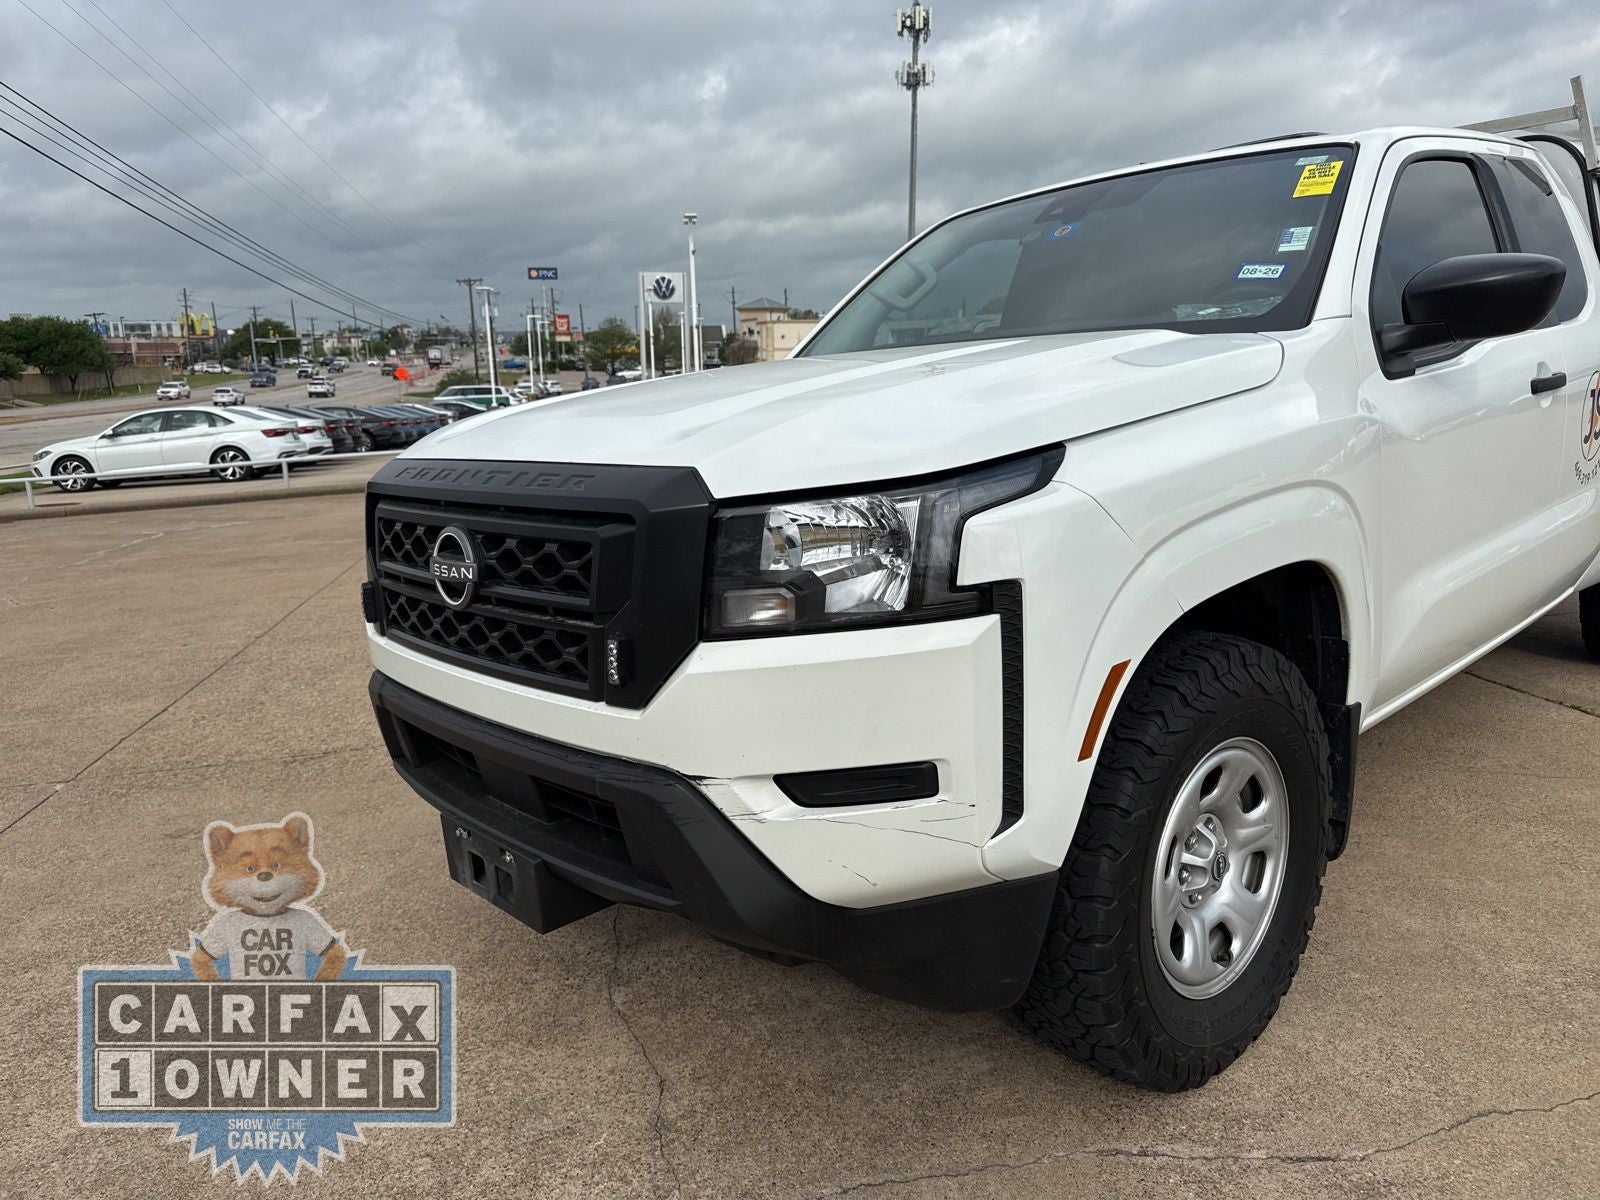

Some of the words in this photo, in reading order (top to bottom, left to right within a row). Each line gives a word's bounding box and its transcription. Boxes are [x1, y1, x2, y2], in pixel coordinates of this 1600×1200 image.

[1307, 165, 1336, 173] VEHICLE
[538, 270, 556, 278] PNC
[395, 467, 596, 491] FRONTIER
[432, 563, 473, 579] SSAN
